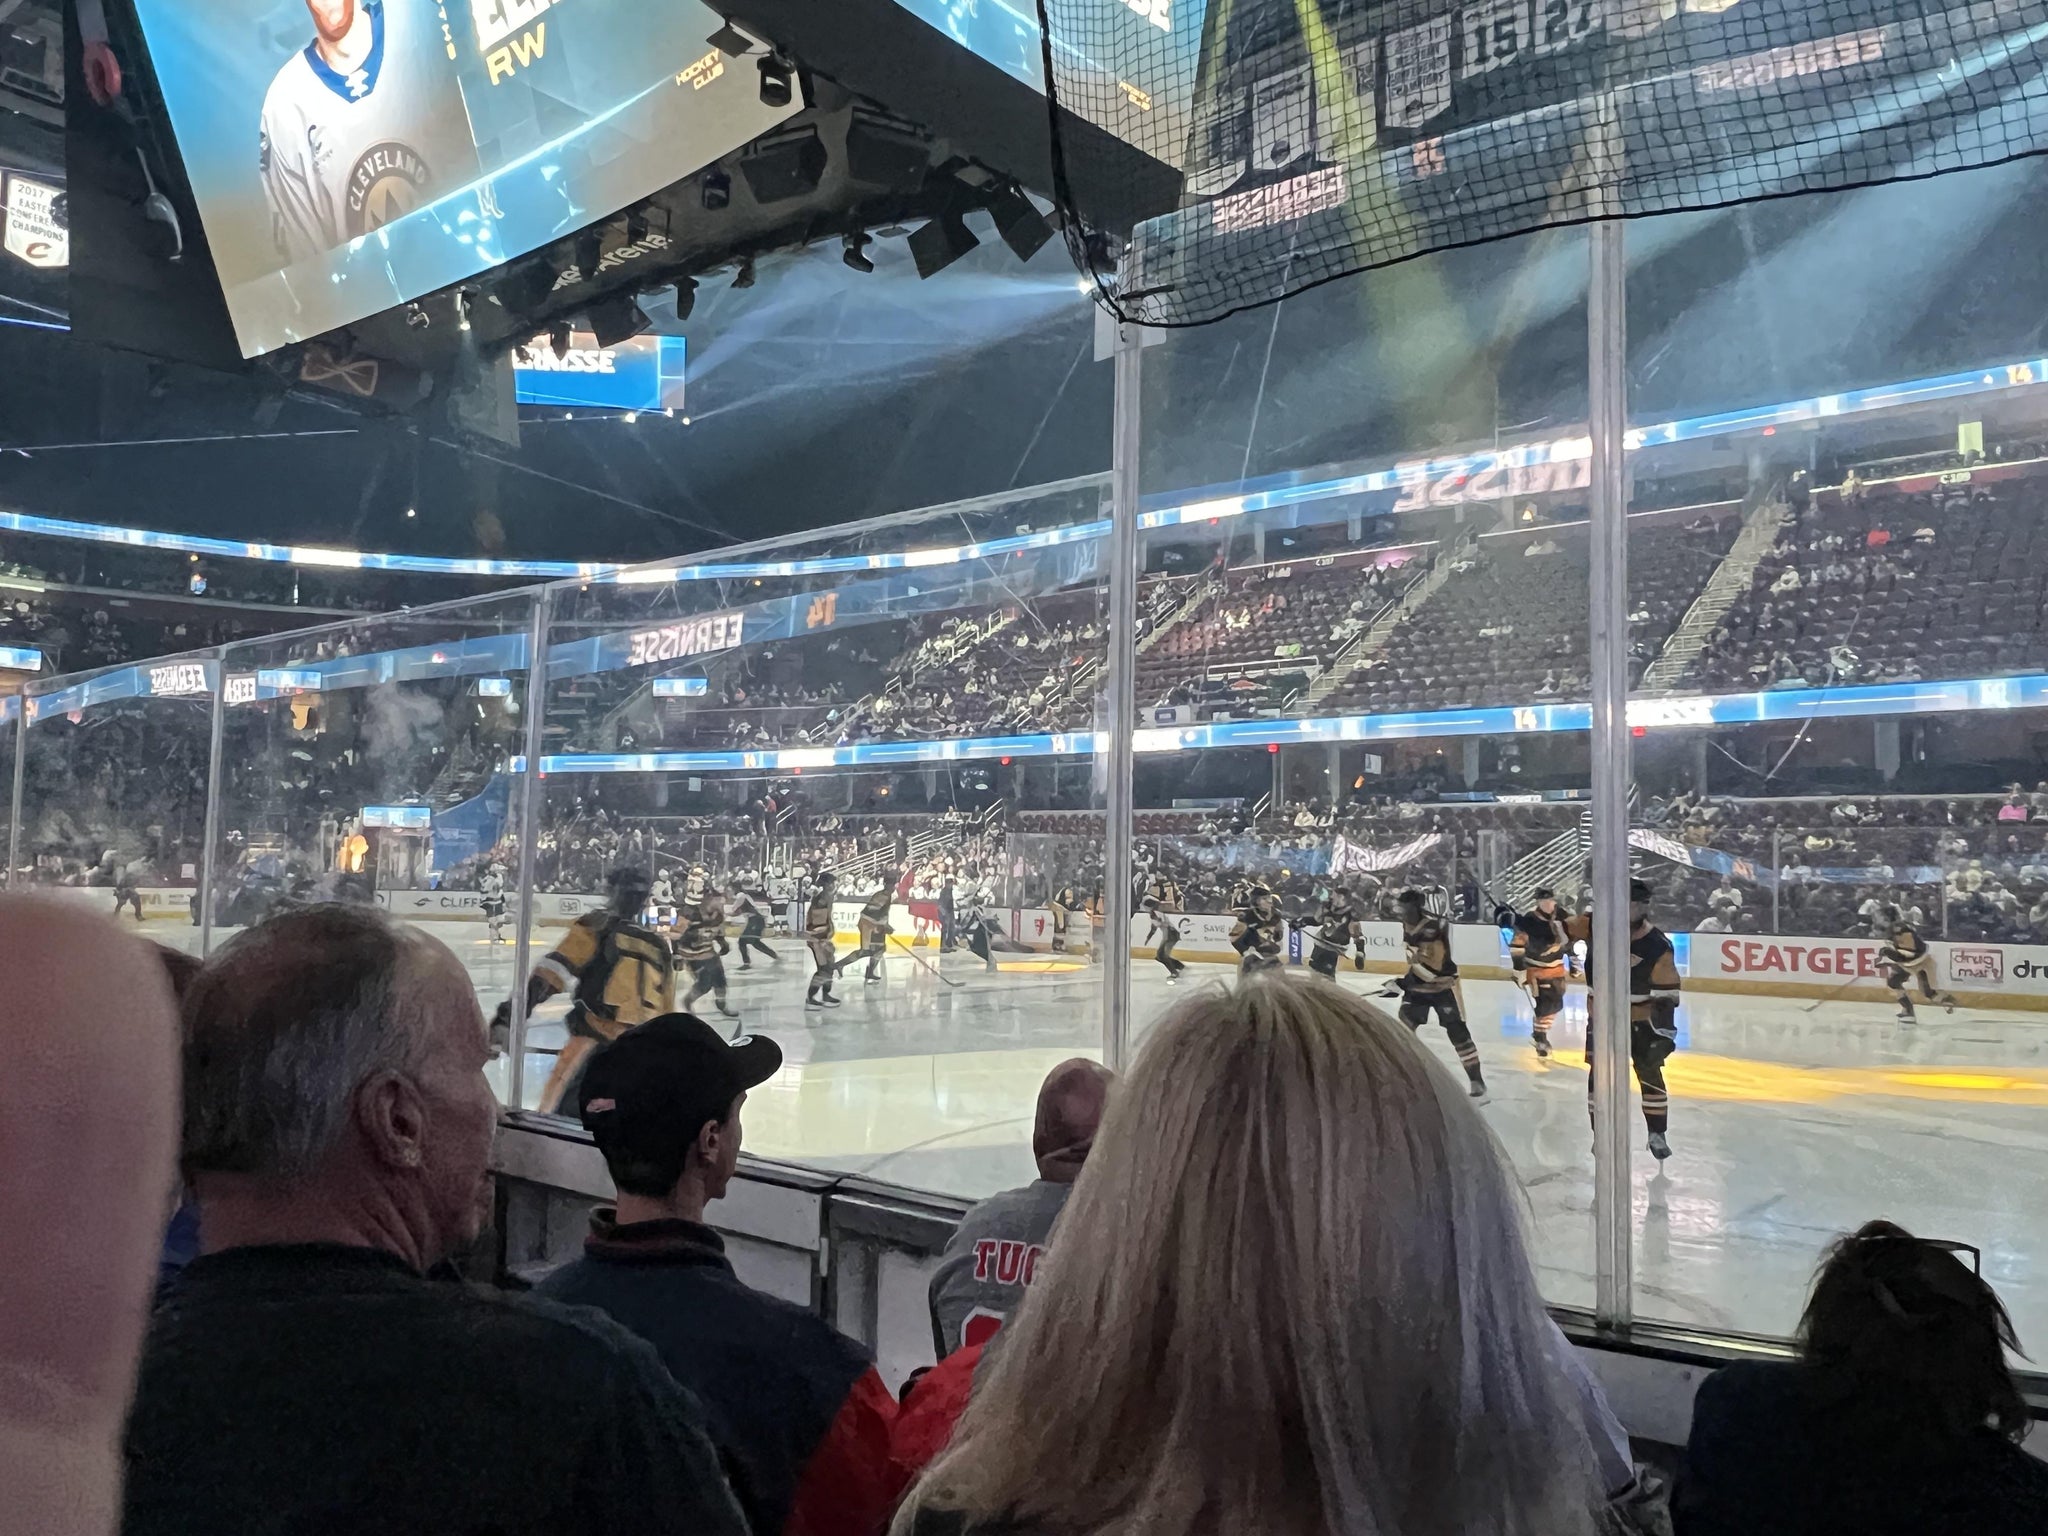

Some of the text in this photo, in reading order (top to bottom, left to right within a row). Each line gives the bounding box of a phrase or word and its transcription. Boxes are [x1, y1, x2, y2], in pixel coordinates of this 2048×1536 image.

[486, 22, 545, 86] RW
[675, 47, 720, 86] HOCKEY
[693, 62, 724, 91] CLUB
[17, 183, 45, 199] 2017
[350, 150, 426, 212] CLEVELAND
[18, 198, 51, 214] EASTE
[12, 219, 64, 242] CHAMPIONS
[2006, 364, 2033, 385] 14
[1512, 708, 1538, 730] 14
[440, 896, 485, 909] CLIFF
[1203, 924, 1226, 933] SAVE
[1953, 950, 1995, 969] drug
